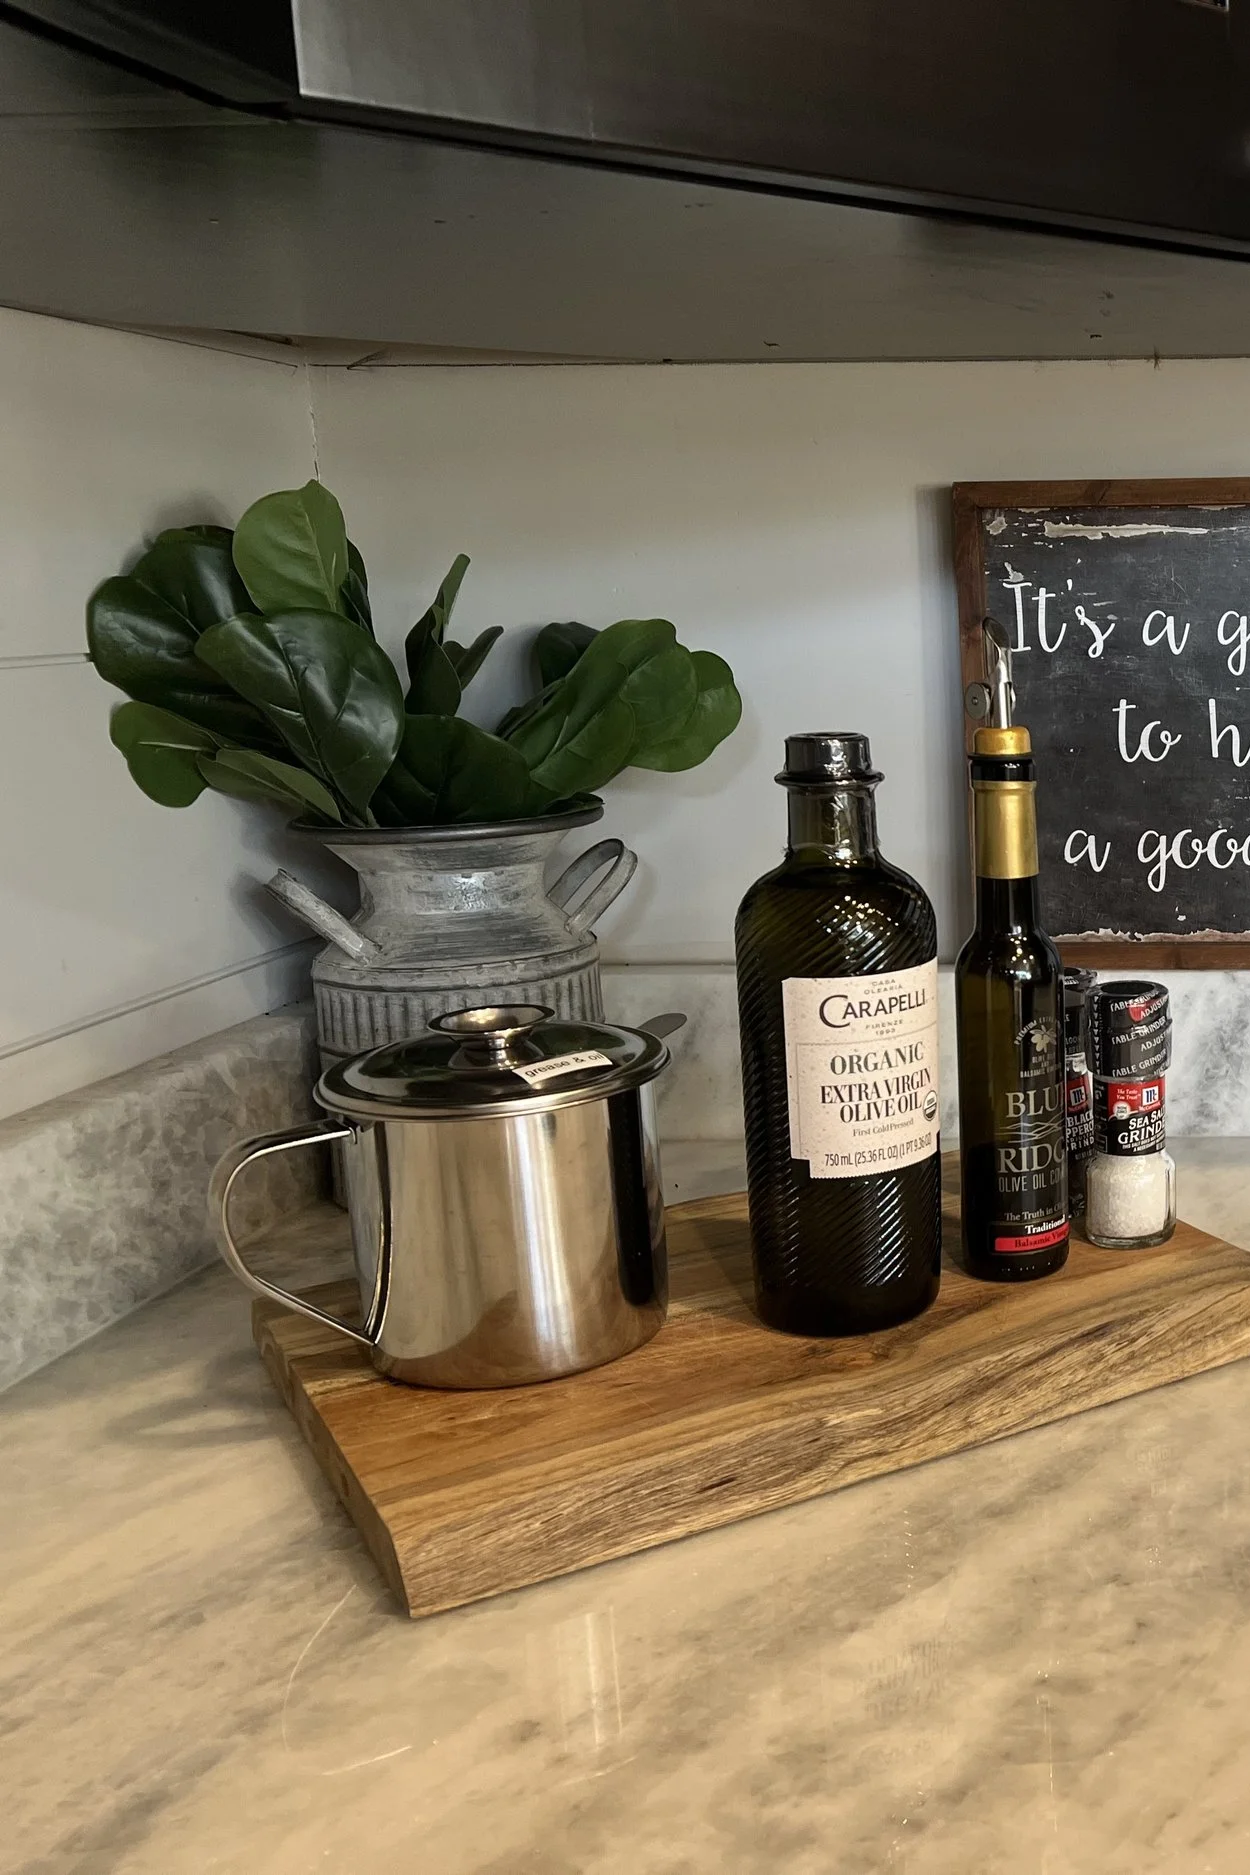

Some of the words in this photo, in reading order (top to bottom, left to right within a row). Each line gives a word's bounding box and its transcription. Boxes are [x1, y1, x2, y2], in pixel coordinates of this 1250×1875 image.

[1002, 578, 1115, 659] It's
[1141, 609, 1190, 656] a
[1112, 698, 1182, 763] to
[1063, 829, 1111, 872] a
[819, 988, 926, 1028] CARAPELLI
[525, 1061, 570, 1078] grease
[573, 1056, 586, 1064] &
[830, 1041, 924, 1075] ORGANIC
[820, 1081, 882, 1104] EXTRA
[884, 1067, 931, 1097] VIRGIN
[840, 1098, 895, 1123] OLIVE
[898, 1092, 922, 1114] OIL
[1129, 1116, 1150, 1130] SEA
[853, 1127, 871, 1137] First
[825, 1154, 839, 1167] 750
[841, 1152, 853, 1166] mL
[878, 1148, 886, 1161] FL
[999, 1176, 1028, 1193] OLIVE
[1032, 1172, 1047, 1190] OIL
[1004, 1212, 1020, 1221] The
[1022, 1209, 1045, 1220] Truth
